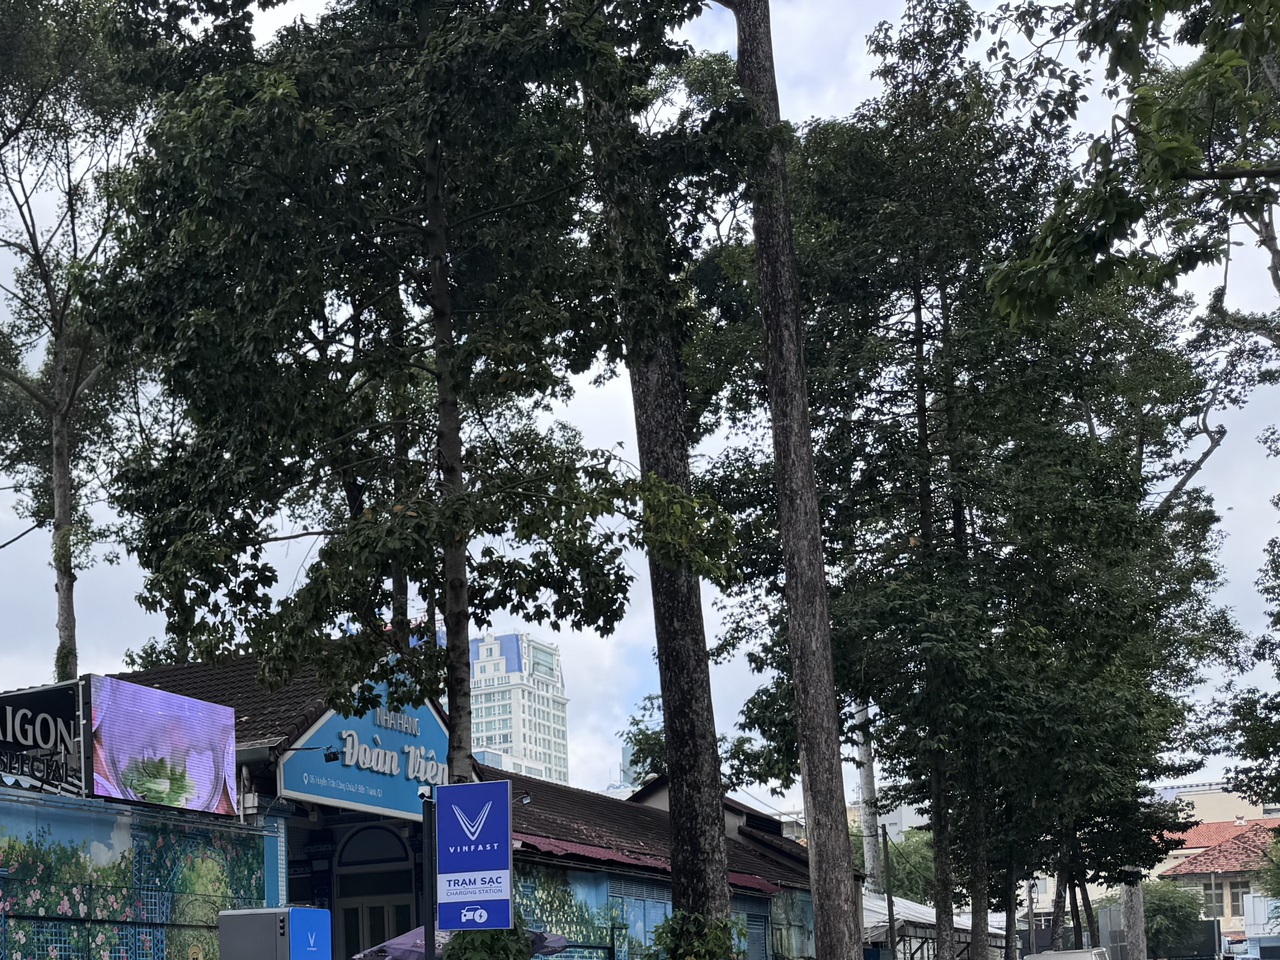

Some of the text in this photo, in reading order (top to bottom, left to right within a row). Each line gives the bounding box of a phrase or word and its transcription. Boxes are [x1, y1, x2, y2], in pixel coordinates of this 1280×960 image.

[339, 730, 448, 785] Đoàn Viên
[449, 843, 499, 853] VINFAST
[446, 876, 502, 888] TRẠM SẠC
